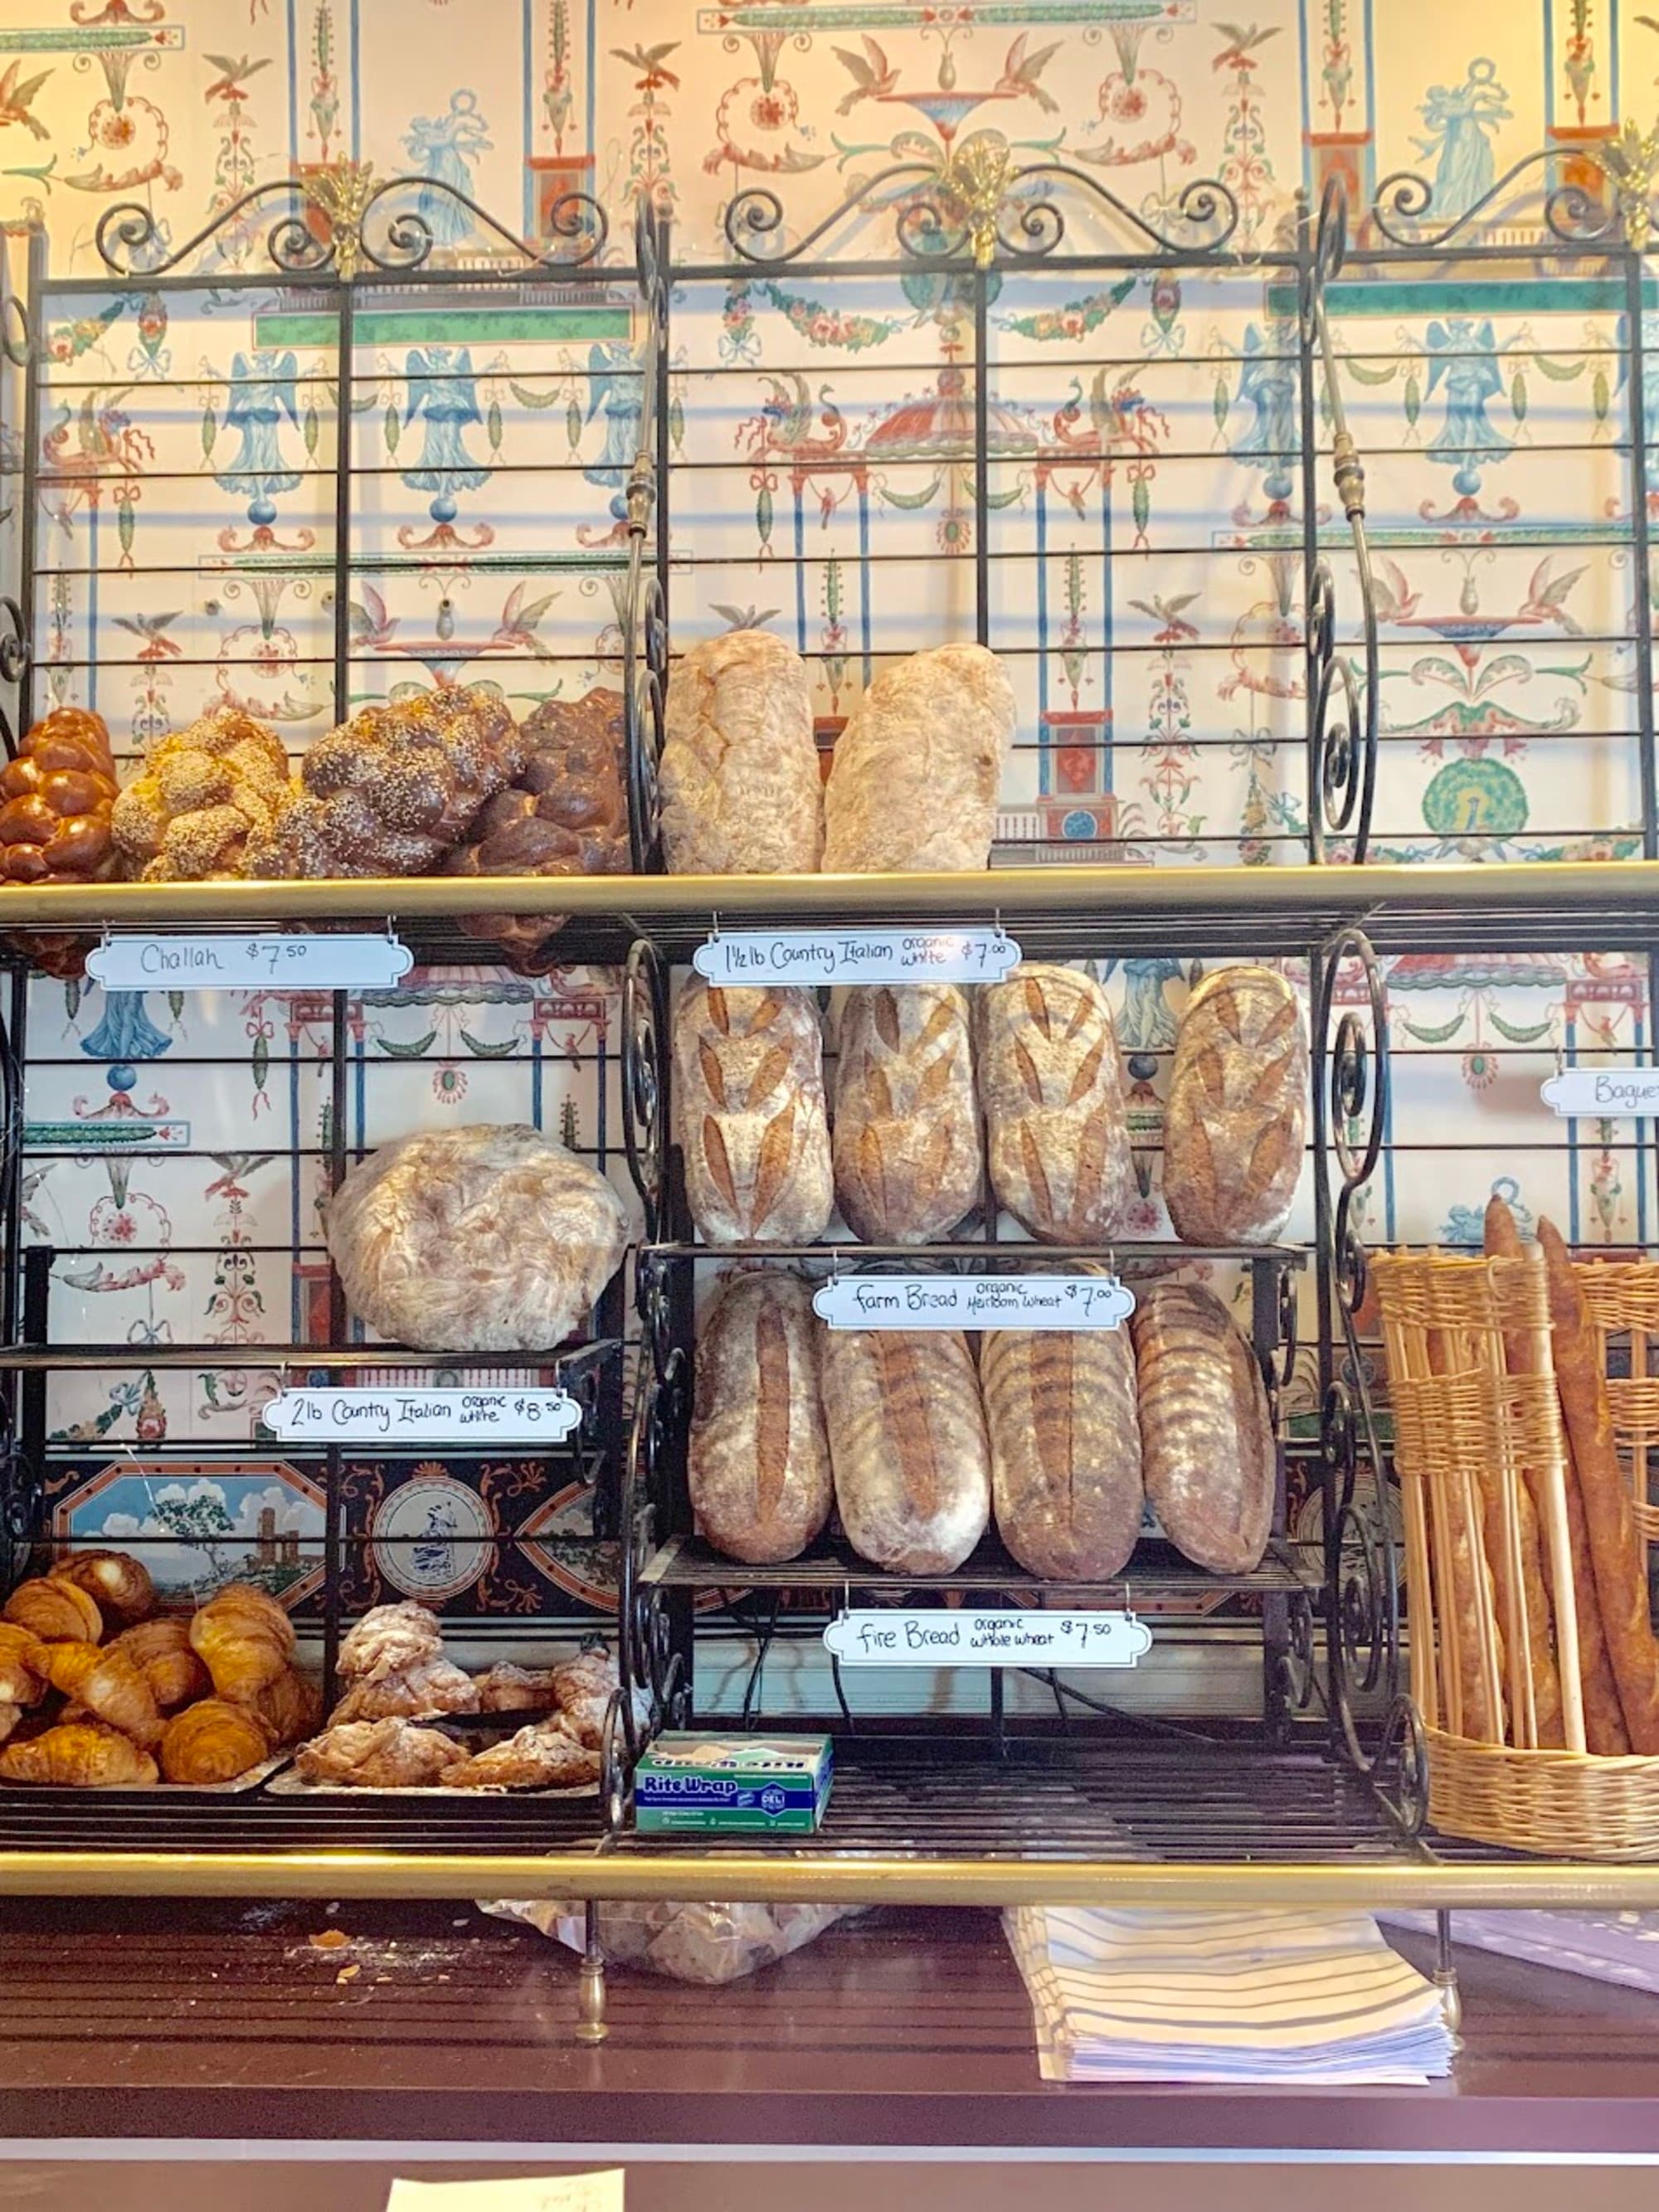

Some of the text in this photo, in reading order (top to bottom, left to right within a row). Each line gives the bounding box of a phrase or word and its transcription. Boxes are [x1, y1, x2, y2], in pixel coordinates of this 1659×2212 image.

[902, 936, 955, 950] organic
[961, 941, 1006, 969] $7.00
[140, 943, 226, 973] Challah
[771, 941, 835, 974] Country
[838, 940, 893, 965] Italian
[901, 948, 946, 966] white
[1595, 1075, 1659, 1109] Bague
[904, 1283, 957, 1310] Bread
[975, 1282, 1028, 1299] organic
[1064, 1284, 1112, 1317] $7.00
[332, 1399, 391, 1432] Country
[395, 1398, 451, 1423] Italian
[460, 1410, 499, 1423] white
[462, 1396, 507, 1410] organic
[903, 1620, 960, 1650] Bread
[970, 1632, 1011, 1647] whole
[974, 1618, 1024, 1634] organic
